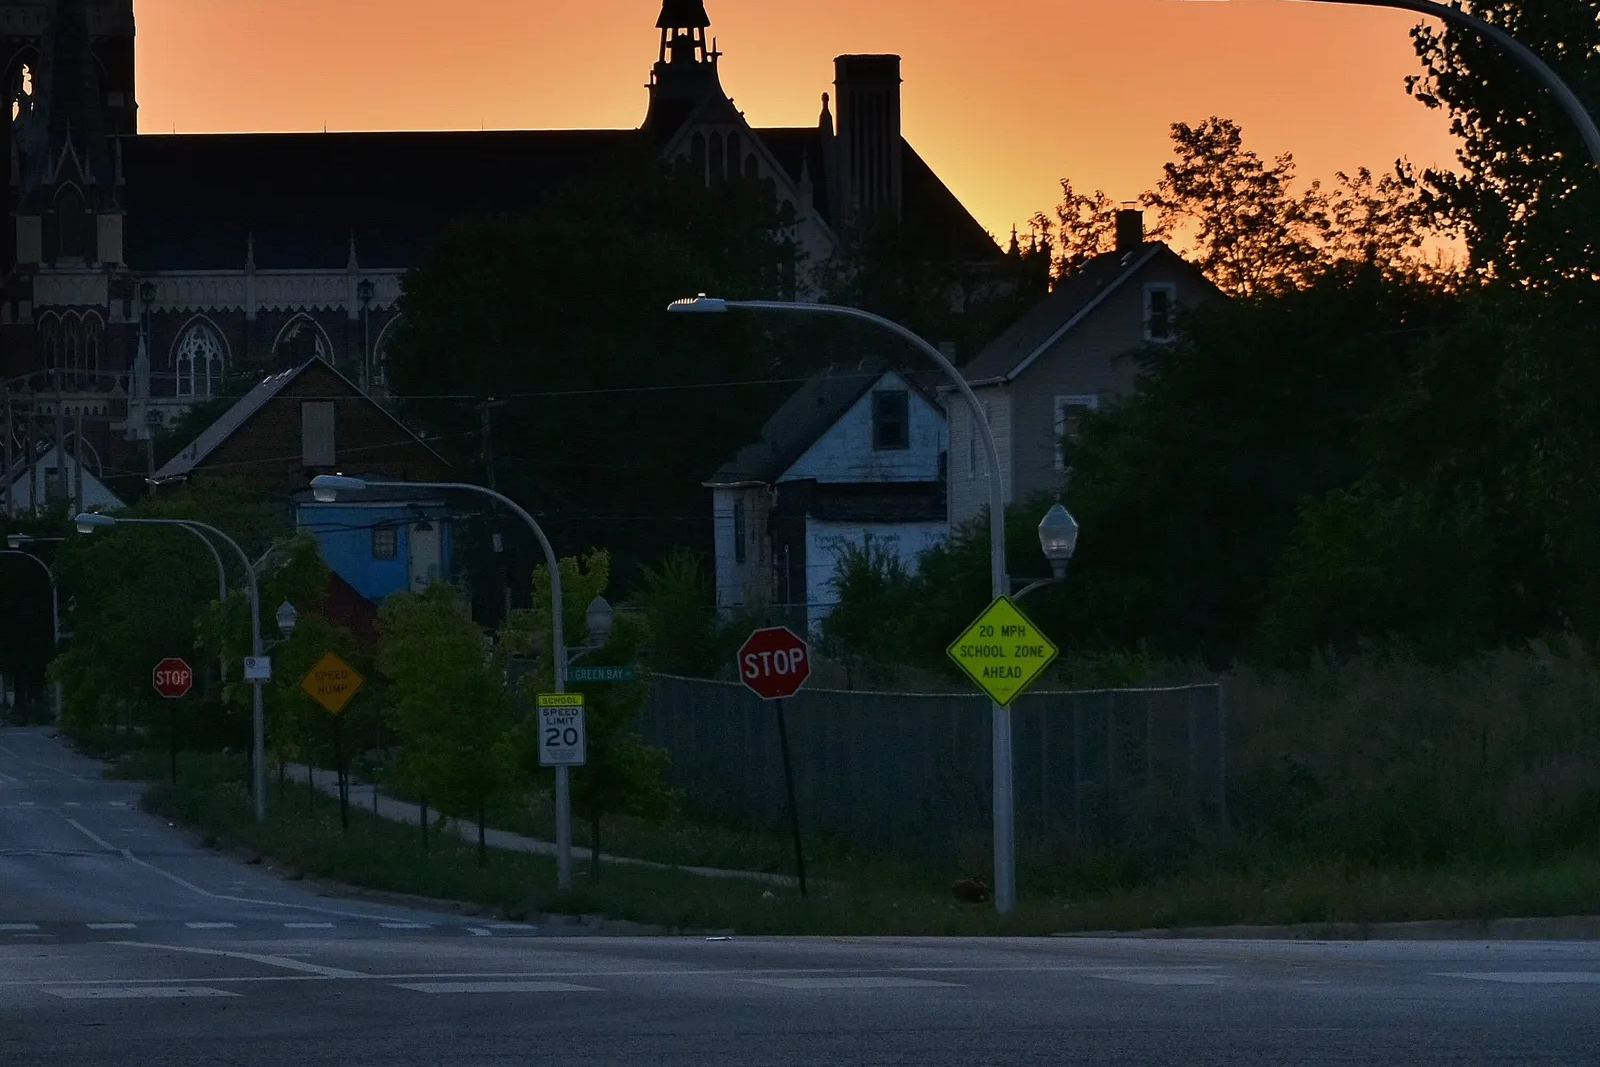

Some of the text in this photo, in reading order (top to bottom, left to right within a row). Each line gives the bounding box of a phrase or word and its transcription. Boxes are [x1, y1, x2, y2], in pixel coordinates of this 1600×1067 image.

[978, 625, 1026, 638] 20 MPH
[960, 645, 1045, 658] SCHOOL ZONE
[744, 647, 805, 679] STOP
[156, 670, 189, 685] STOP
[315, 670, 349, 682] SPEED
[575, 669, 605, 680] GREEN
[607, 669, 624, 679] BAY
[982, 666, 1022, 679] AHEAD
[317, 684, 349, 695] HUMP
[542, 697, 579, 705] SCHOOL
[542, 708, 579, 717] SPEED
[546, 717, 575, 725] LIMIT
[546, 727, 578, 747] 20
